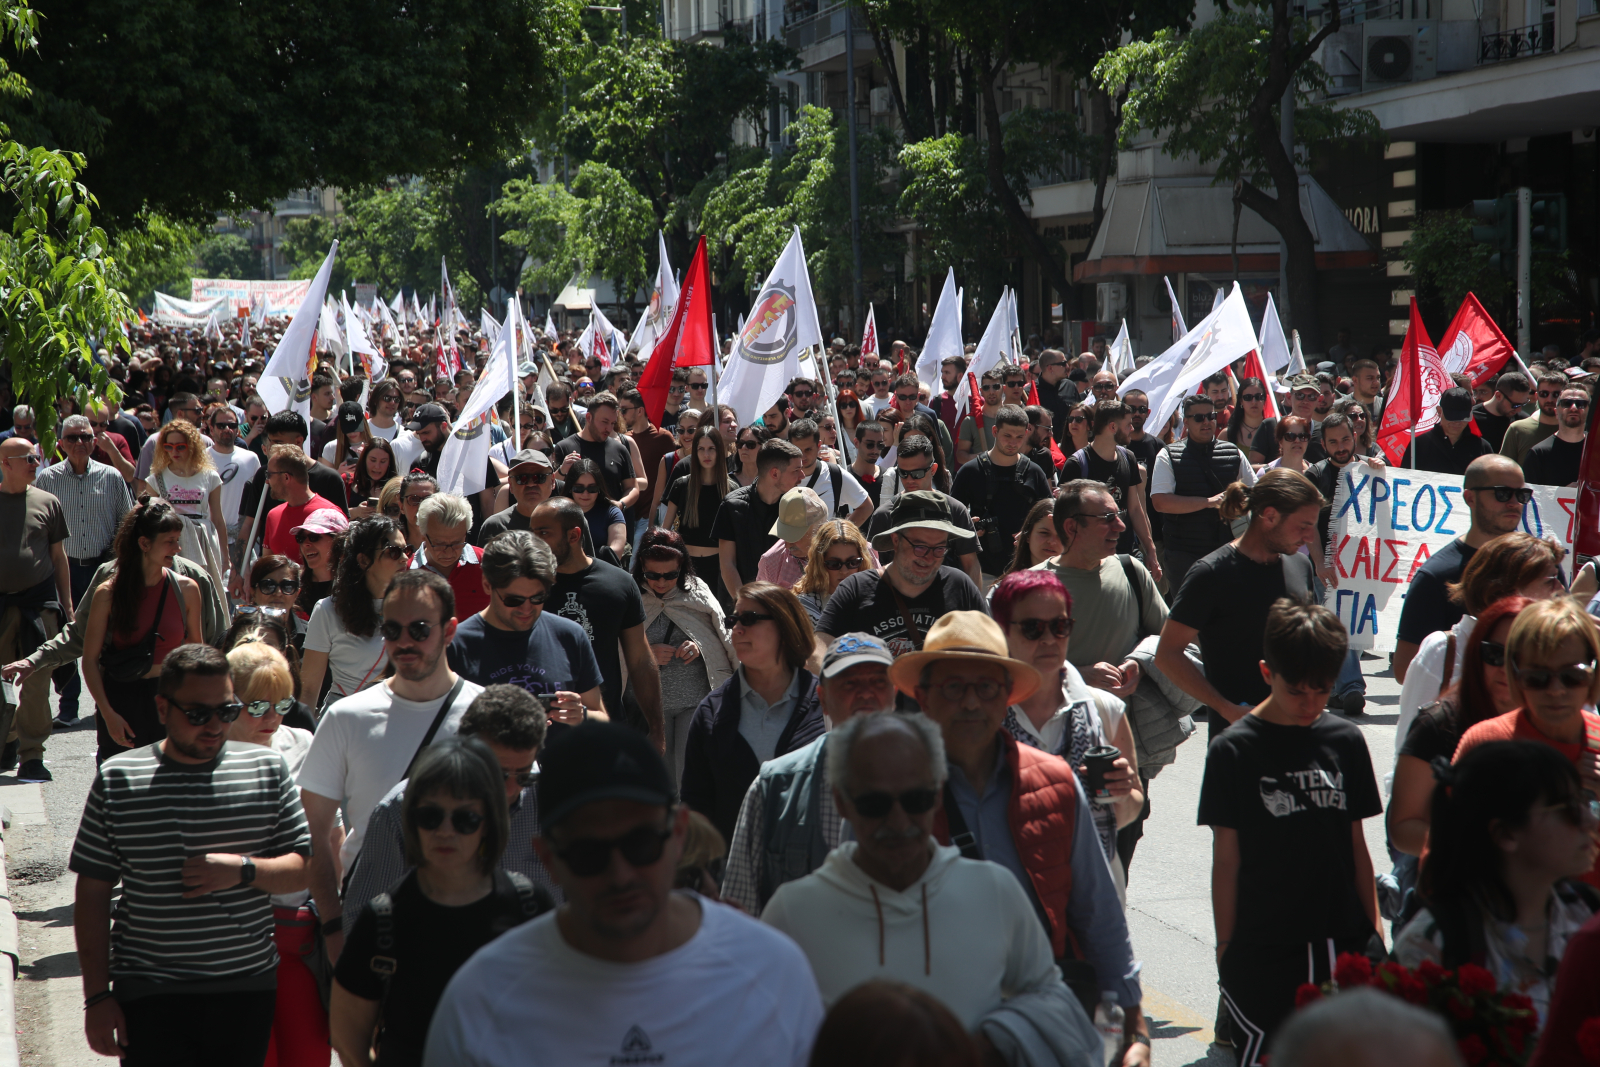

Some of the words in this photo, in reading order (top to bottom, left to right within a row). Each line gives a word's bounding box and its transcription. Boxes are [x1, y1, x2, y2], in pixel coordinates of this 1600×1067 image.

[1336, 471, 1462, 535] ΧΡΕΟΣ
[1333, 534, 1432, 584] ΚΑΙΣΑ
[872, 613, 938, 636] ASSOIATI
[489, 664, 514, 679] RIDE
[516, 663, 546, 676] YOUR
